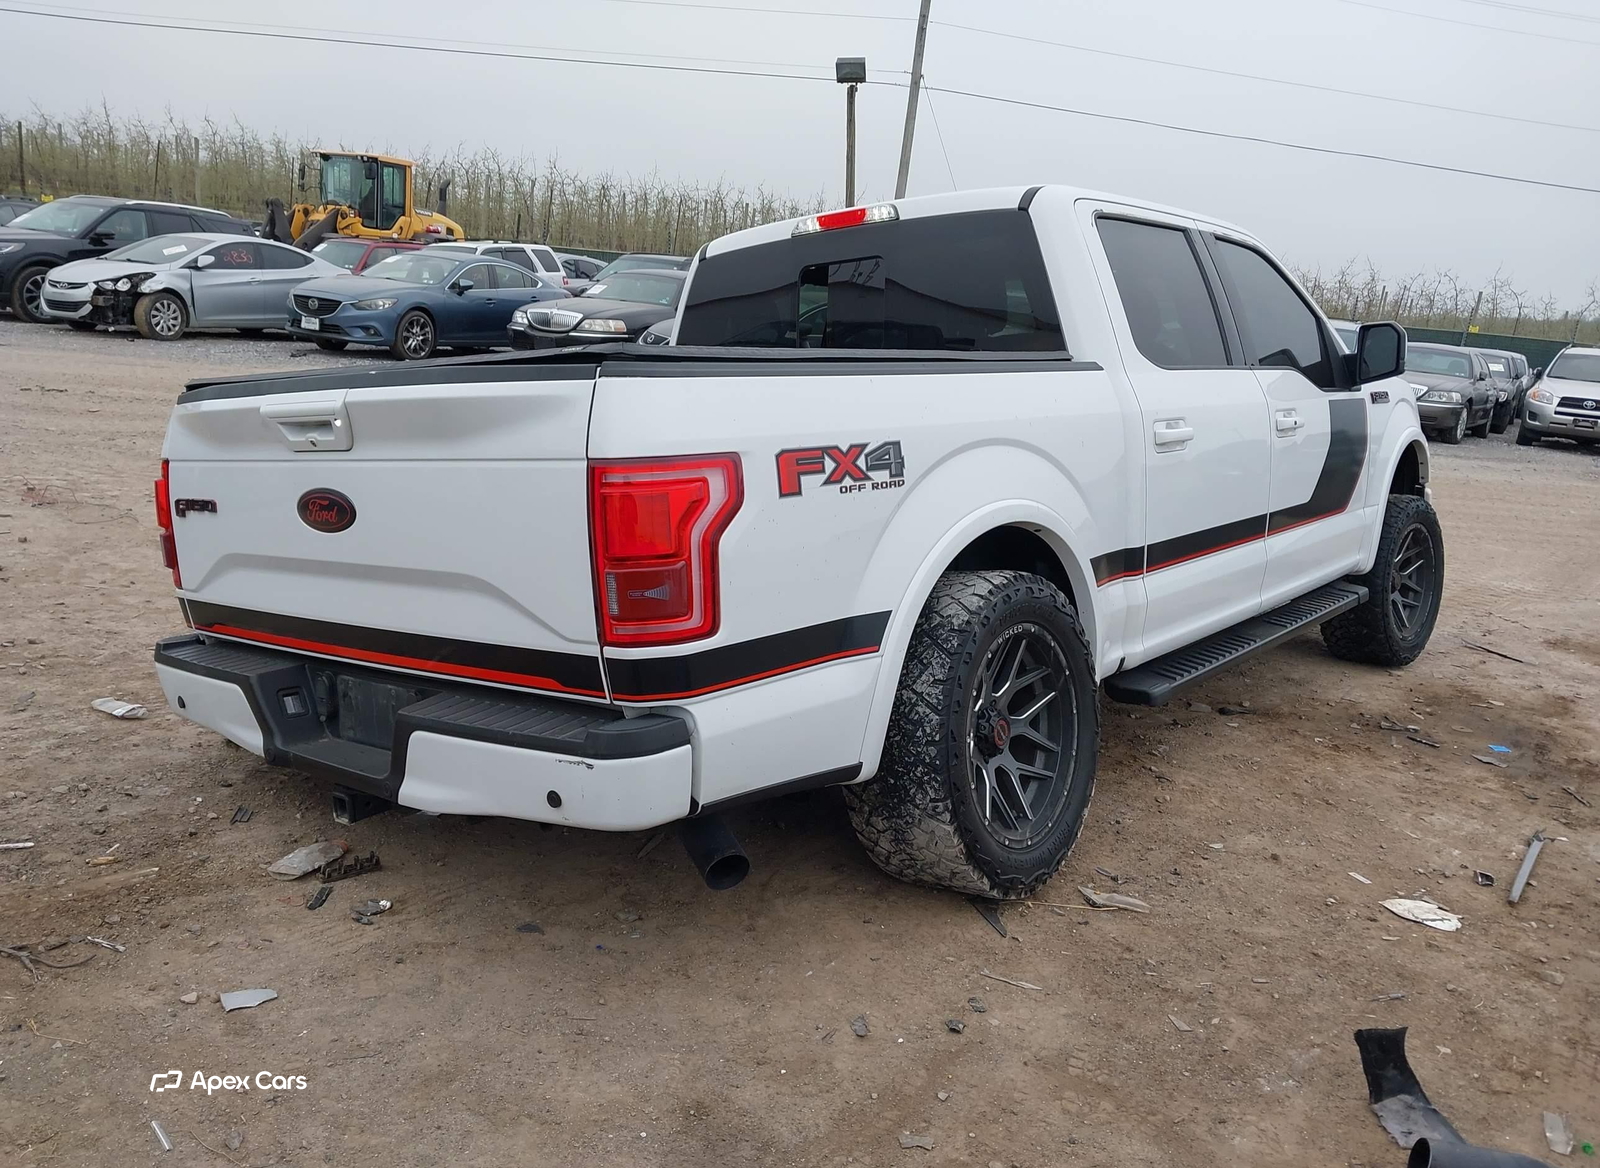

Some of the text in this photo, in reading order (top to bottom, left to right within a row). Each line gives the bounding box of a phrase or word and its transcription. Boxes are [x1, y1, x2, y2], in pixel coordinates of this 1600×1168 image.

[774, 439, 906, 499] FX4
[839, 479, 906, 495] OFF ROAD
[306, 499, 338, 523] Ford
[997, 625, 1023, 645] WICKED
